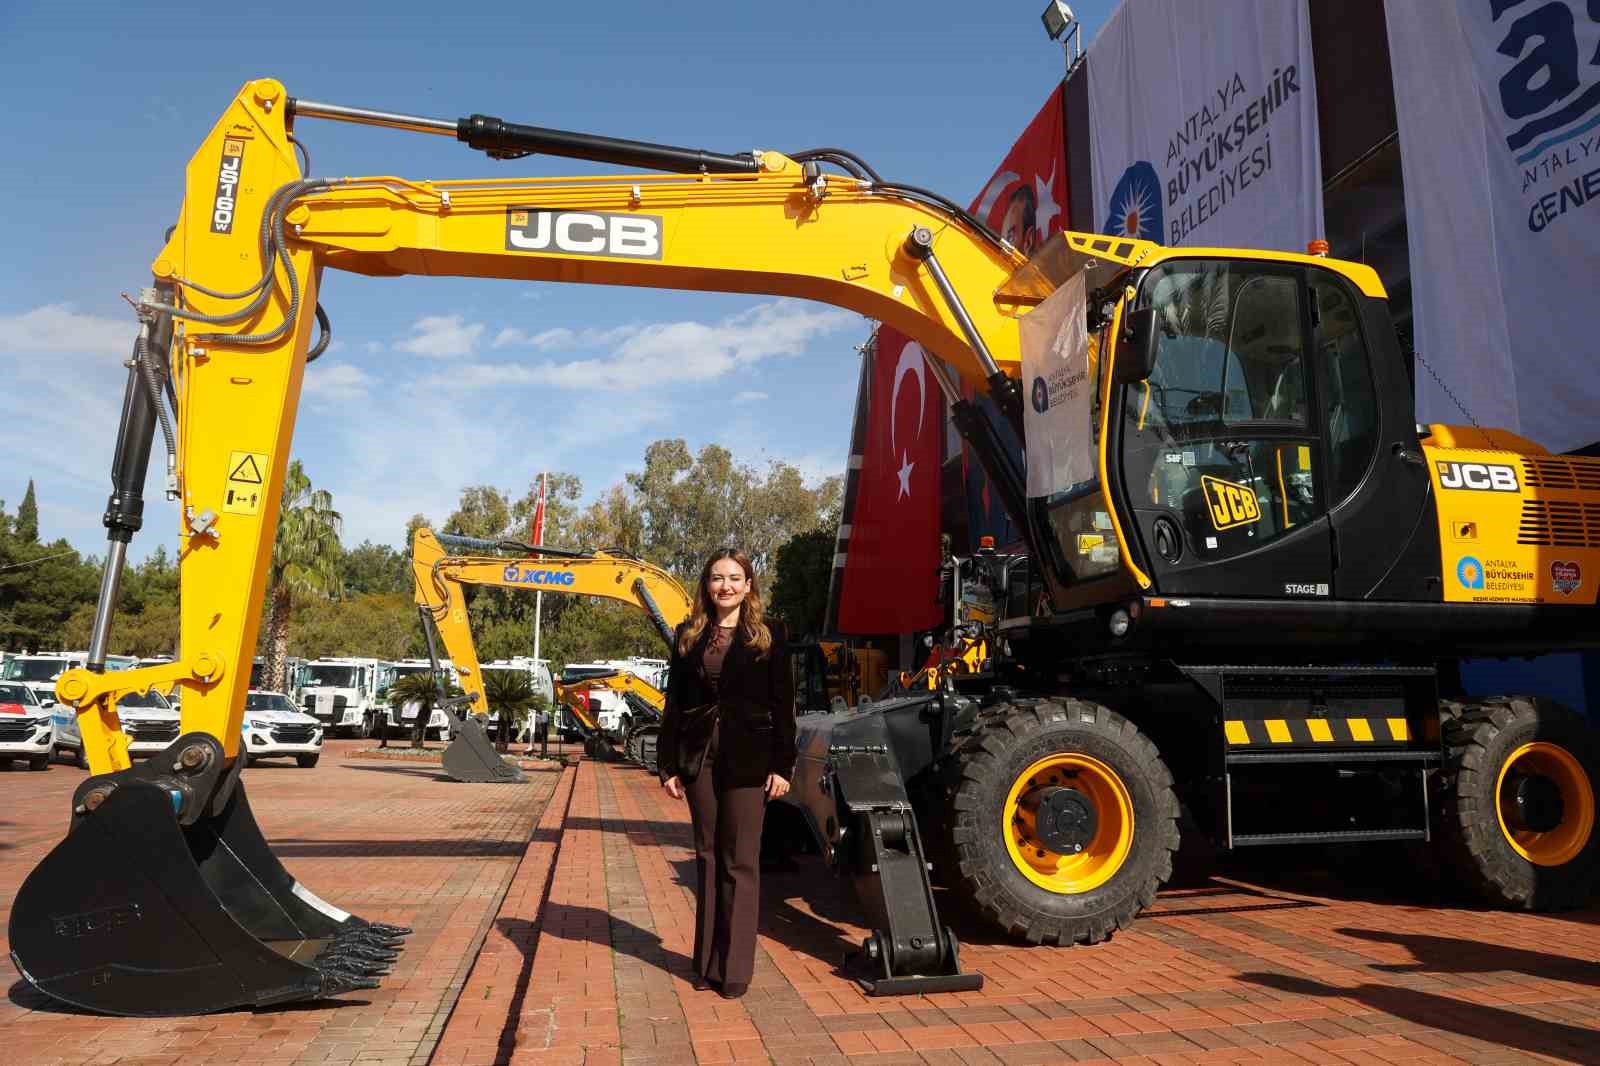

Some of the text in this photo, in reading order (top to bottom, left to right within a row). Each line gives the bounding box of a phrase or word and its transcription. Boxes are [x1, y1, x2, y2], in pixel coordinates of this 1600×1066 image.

[1167, 72, 1246, 168] ANTALYA
[1168, 65, 1300, 206] BÜYÜKŞEHİR
[1171, 133, 1272, 247] BELEDİYESİ
[510, 212, 659, 256] JCB
[1440, 463, 1519, 491] JCB
[1212, 481, 1257, 524] JCB
[524, 570, 576, 586] XCMG
[1485, 560, 1518, 569] ANTALYA
[1285, 583, 1316, 594] STAGE
